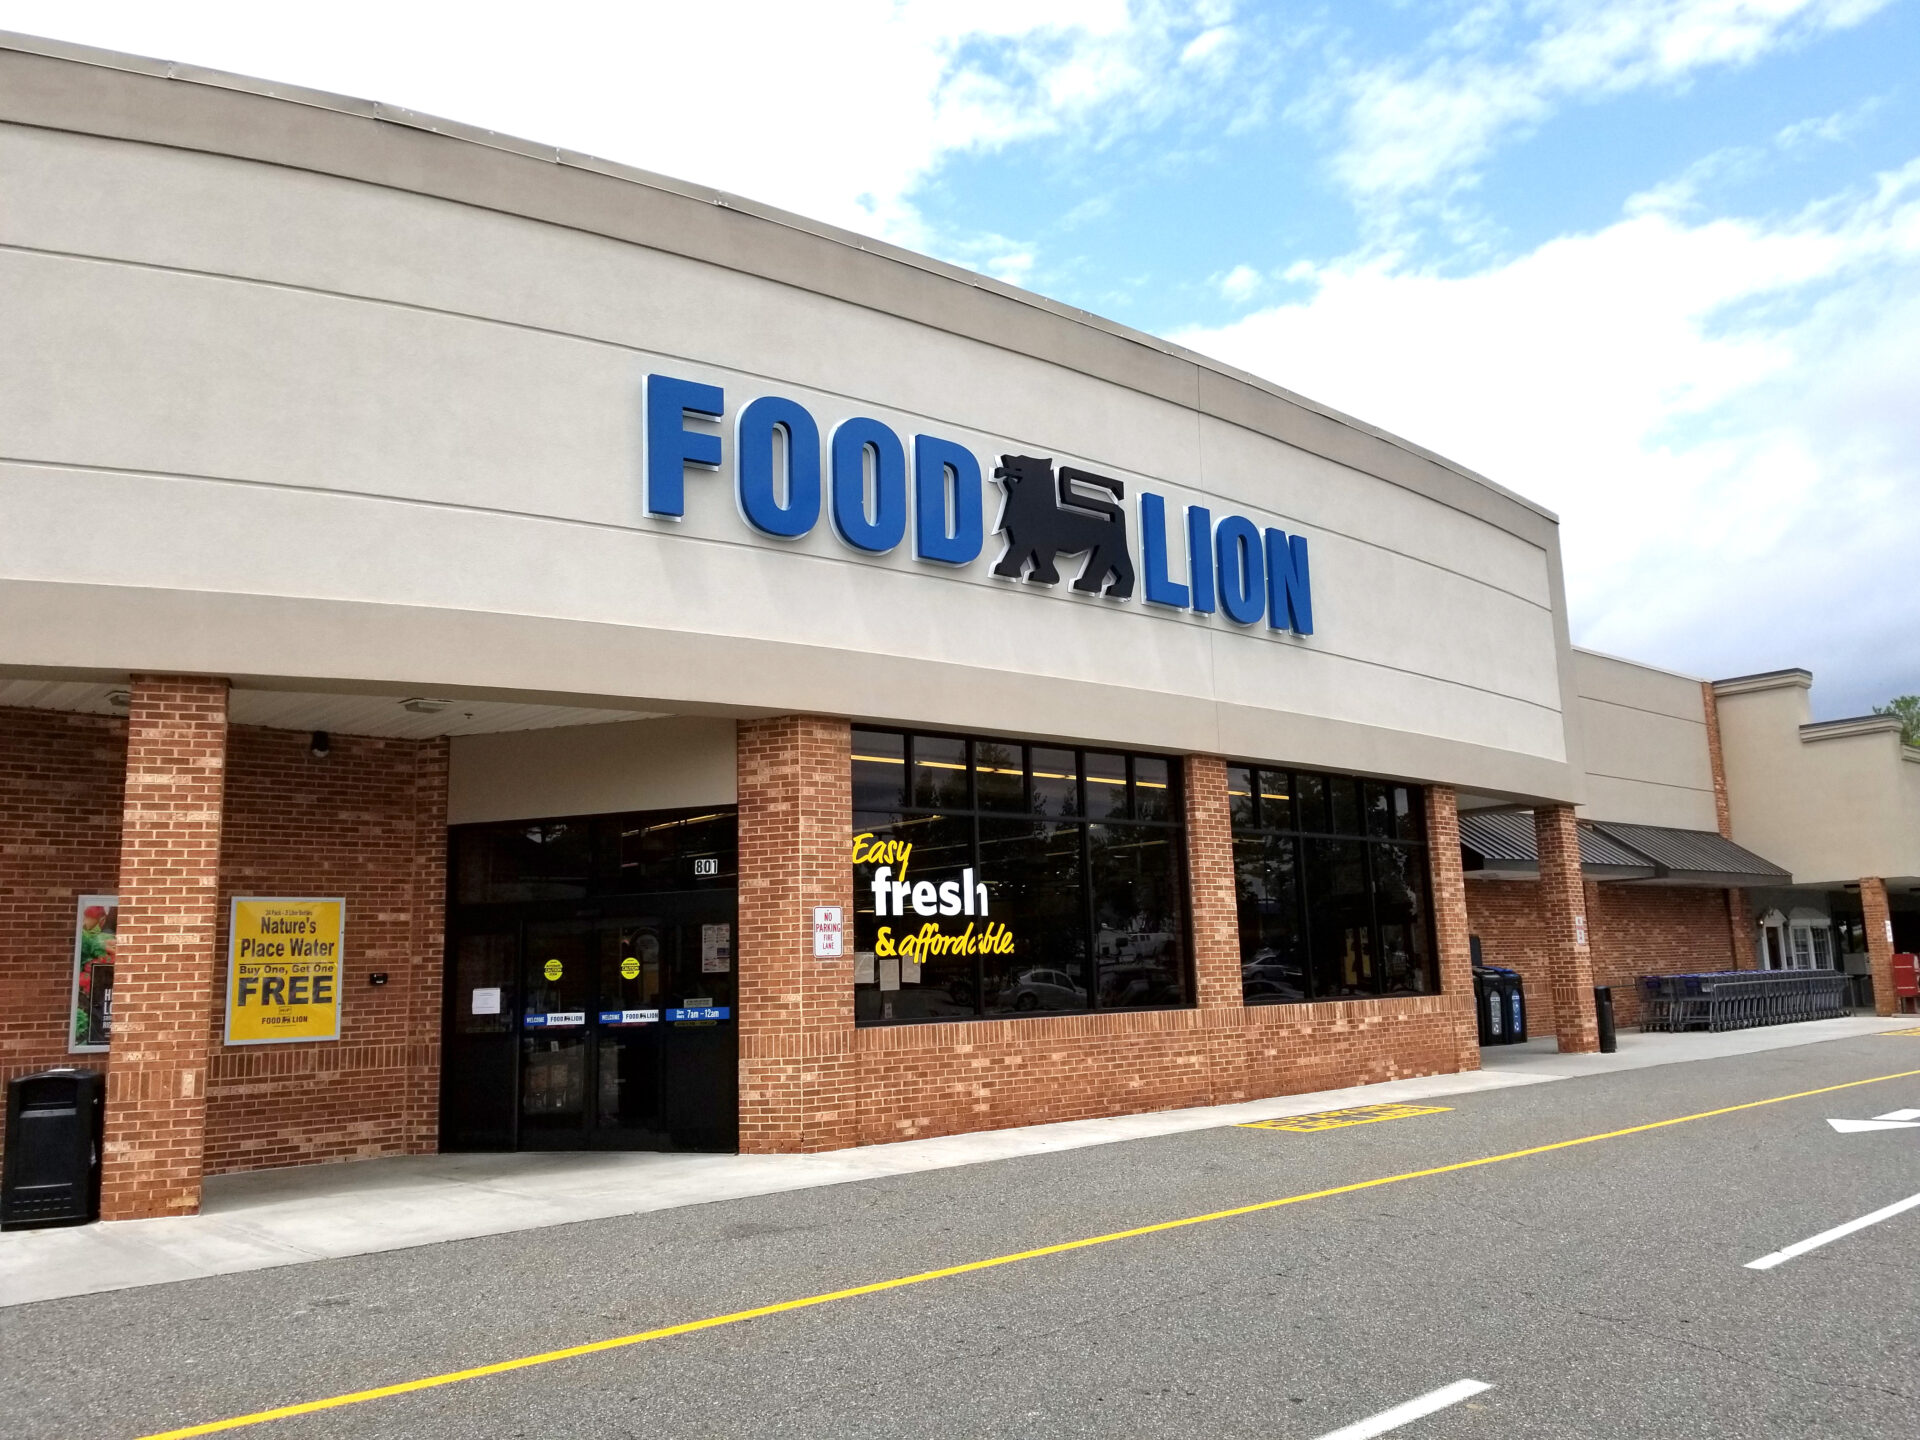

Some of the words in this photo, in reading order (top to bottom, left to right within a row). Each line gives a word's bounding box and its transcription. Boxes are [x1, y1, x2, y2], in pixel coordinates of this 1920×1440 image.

[645, 374, 983, 567] FOOD
[1137, 492, 1315, 638] LION
[852, 833, 912, 881] Easy
[696, 860, 717, 874] 801
[871, 866, 988, 916] fresh
[824, 912, 833, 921] NO
[261, 917, 317, 934] Nature's
[815, 923, 841, 932] PARKING
[823, 933, 834, 941] FIRE
[875, 926, 897, 957] &
[241, 938, 285, 957] Place
[290, 938, 335, 957] Water
[822, 942, 835, 950] LANE
[240, 965, 260, 976] Buy
[264, 965, 288, 975] One,
[292, 964, 311, 973] Get
[314, 964, 334, 973] One
[237, 976, 333, 1006] FREE
[292, 1015, 308, 1023] LION
[687, 1010, 699, 1018] 7am
